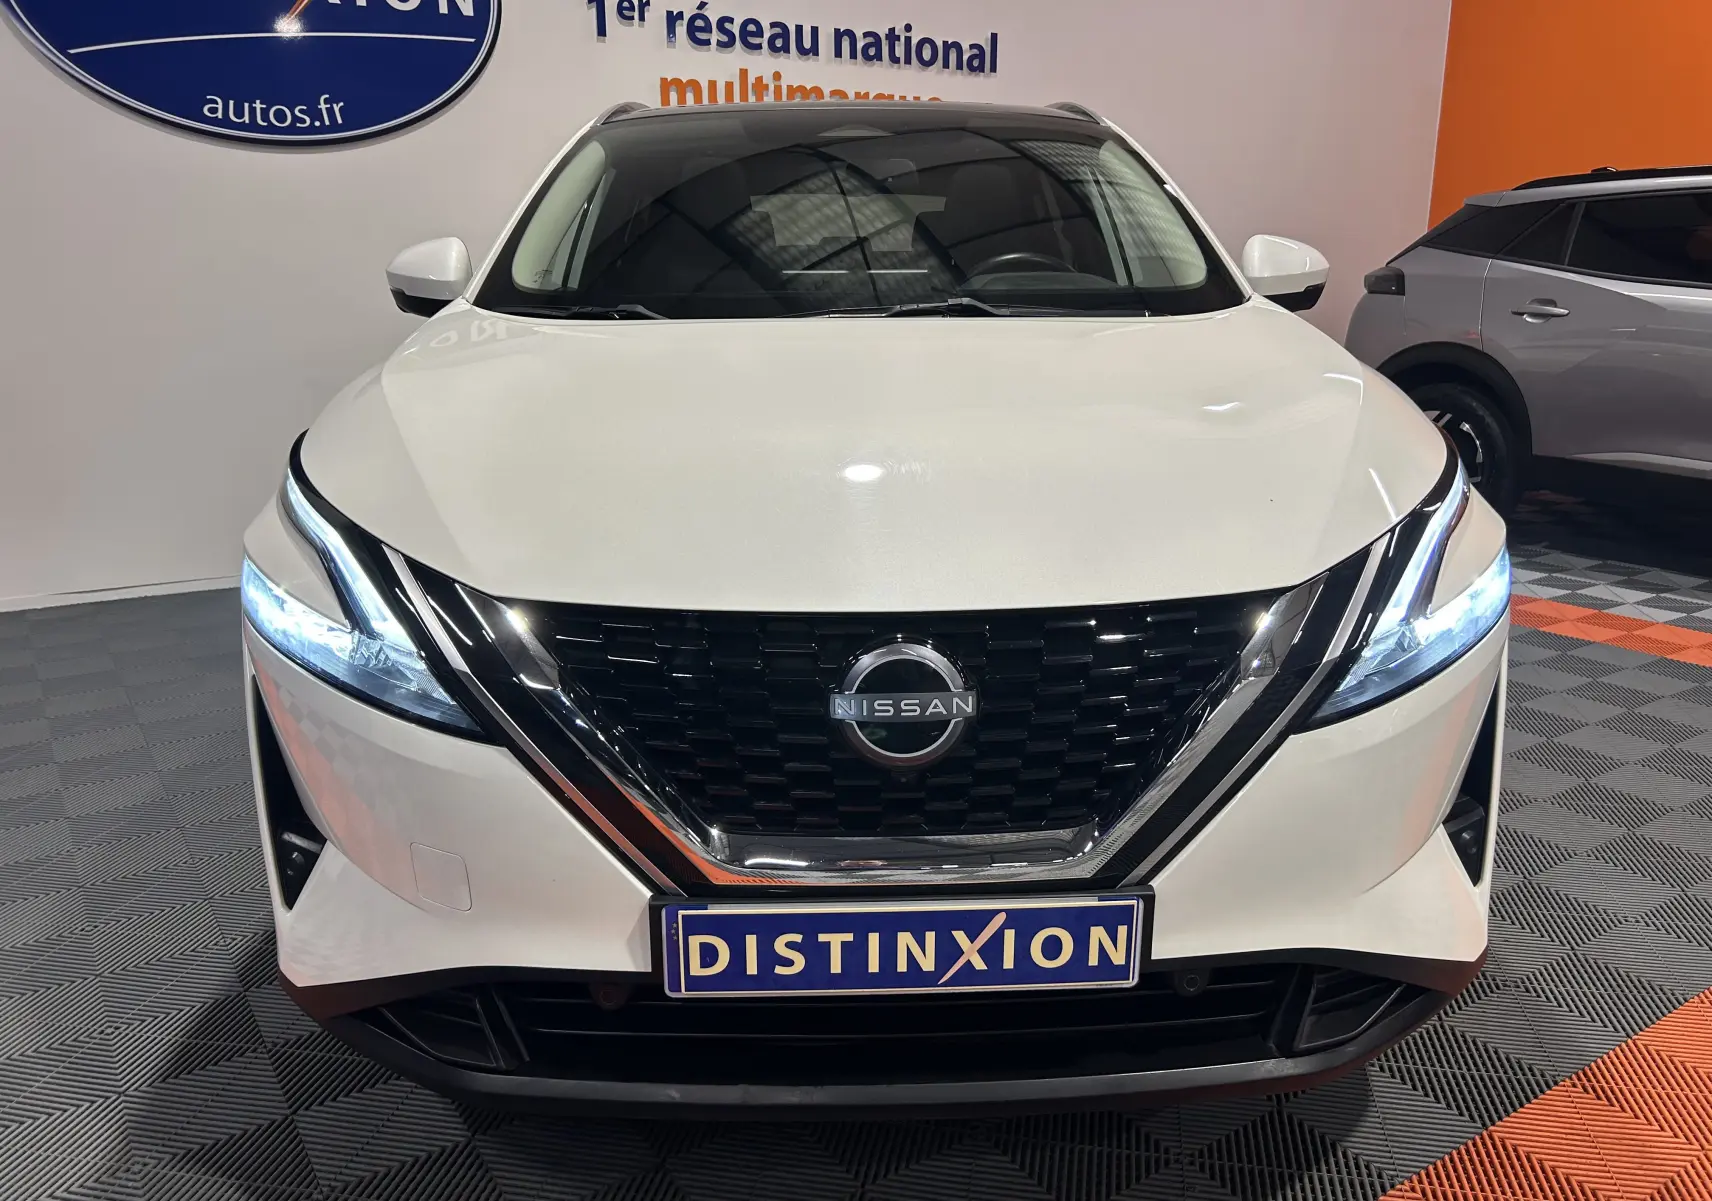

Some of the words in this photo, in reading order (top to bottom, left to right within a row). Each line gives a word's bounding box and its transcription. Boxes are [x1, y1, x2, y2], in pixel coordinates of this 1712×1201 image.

[666, 1, 820, 57] réseau
[833, 23, 998, 74] national
[202, 94, 345, 128] autos.fr
[834, 696, 973, 717] NISSAN
[688, 912, 1128, 984] DISTINXION
